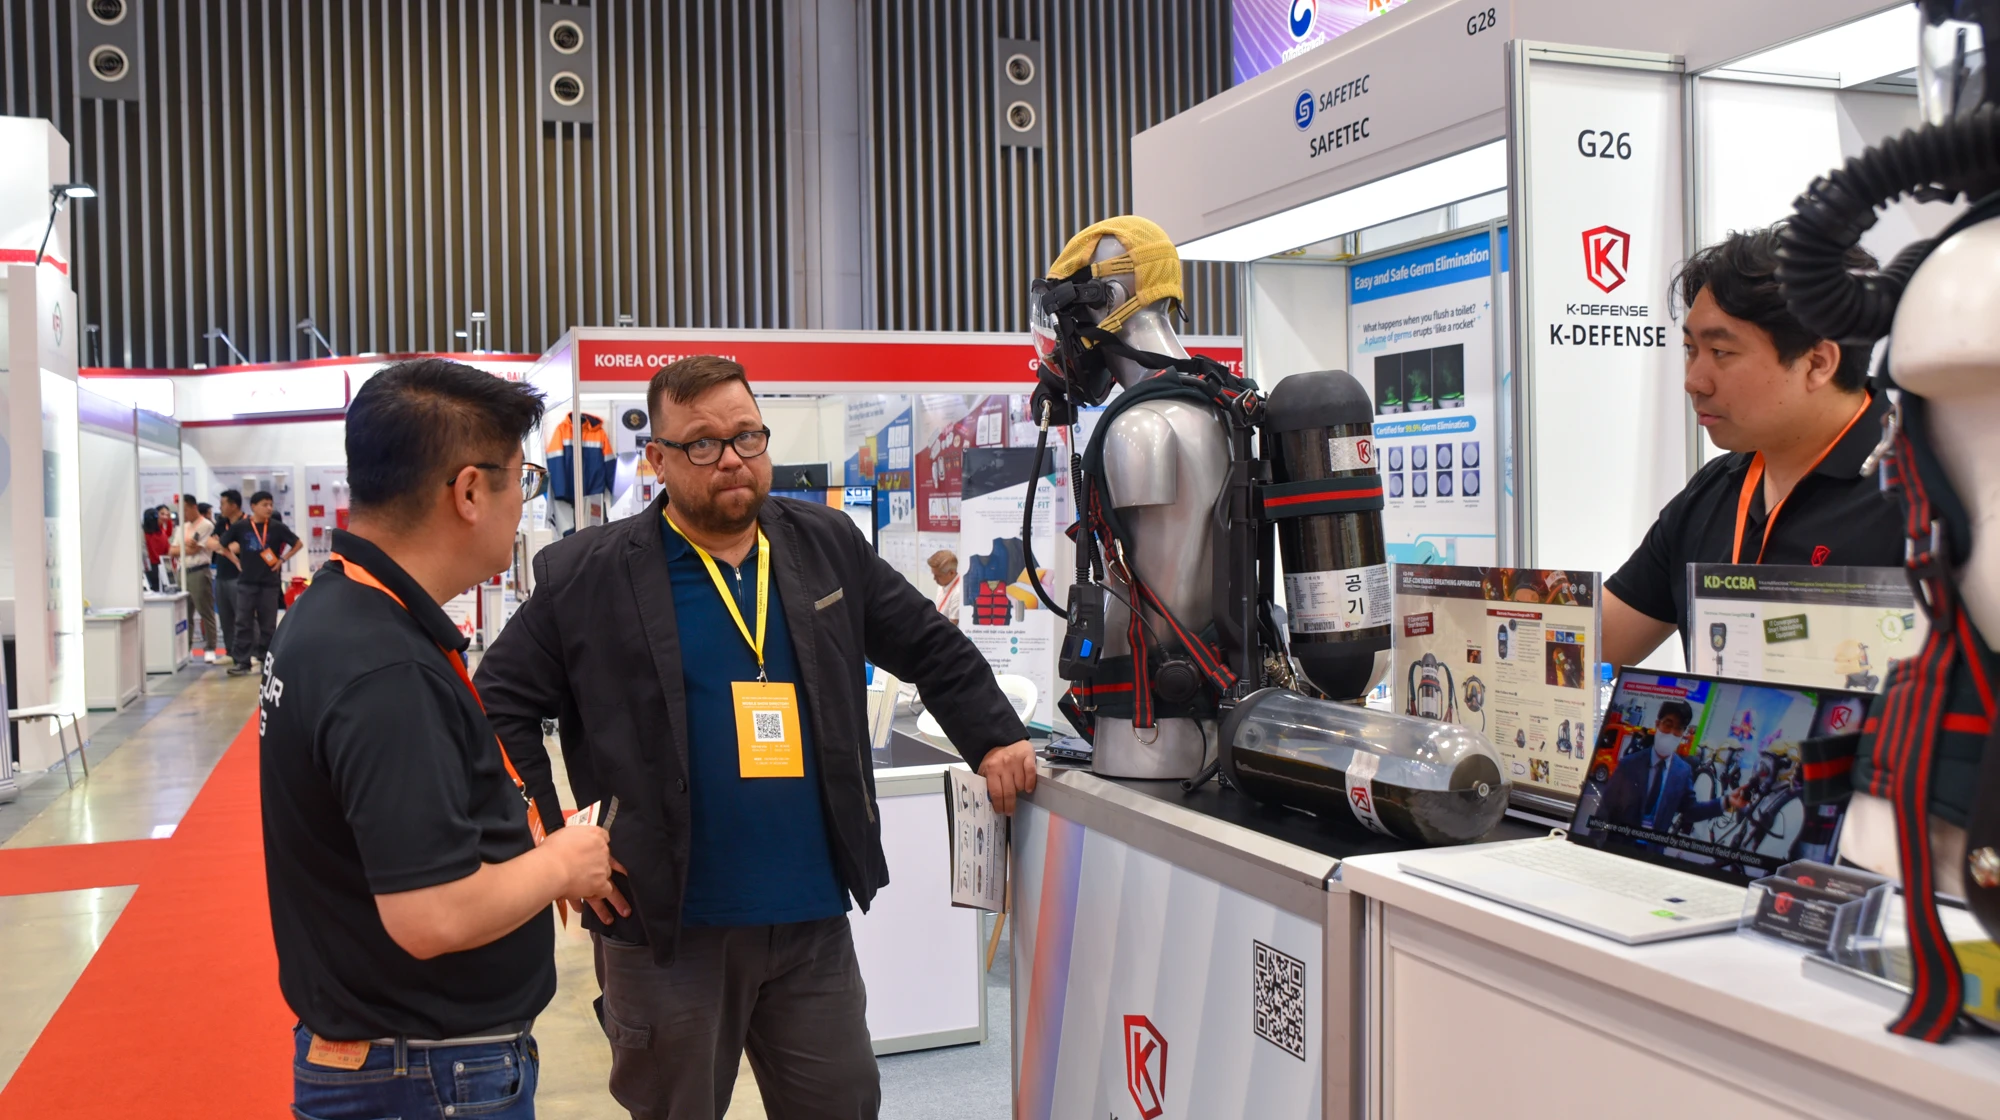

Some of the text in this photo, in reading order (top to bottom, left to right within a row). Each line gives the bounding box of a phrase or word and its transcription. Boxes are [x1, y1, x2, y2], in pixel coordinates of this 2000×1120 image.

[1466, 7, 1496, 36] G28
[1318, 74, 1370, 112] SAFETEC
[1310, 117, 1370, 158] SAFETEC
[1578, 130, 1632, 160] G26
[1354, 248, 1489, 291] Easy and Safe Germ Elimination
[1363, 322, 1377, 333] What
[1378, 318, 1402, 332] happens
[1403, 316, 1420, 326] when
[1420, 315, 1432, 325] you
[1434, 309, 1450, 321] flush
[1455, 304, 1476, 316] toilet?
[1566, 303, 1648, 317] K-DEFENSE
[1387, 332, 1394, 341] of
[1394, 332, 1412, 344] germs
[1413, 328, 1433, 340] erupts
[1550, 324, 1666, 347] K-DEFENSE
[594, 354, 644, 368] KOREA
[1376, 424, 1396, 436] Certified
[1397, 424, 1405, 434] for
[1422, 422, 1436, 432] Germ
[1437, 420, 1470, 431] Elimination
[1704, 575, 1756, 590] KD-CCBA
[1590, 819, 1606, 829] which
[1618, 826, 1631, 836] only
[1631, 829, 1670, 843] exacerbated
[1670, 836, 1678, 846] by
[1679, 837, 1690, 847] the
[1691, 841, 1714, 854] limited
[1715, 846, 1731, 857] field
[1731, 852, 1740, 860] of
[1740, 854, 1761, 864] vision
